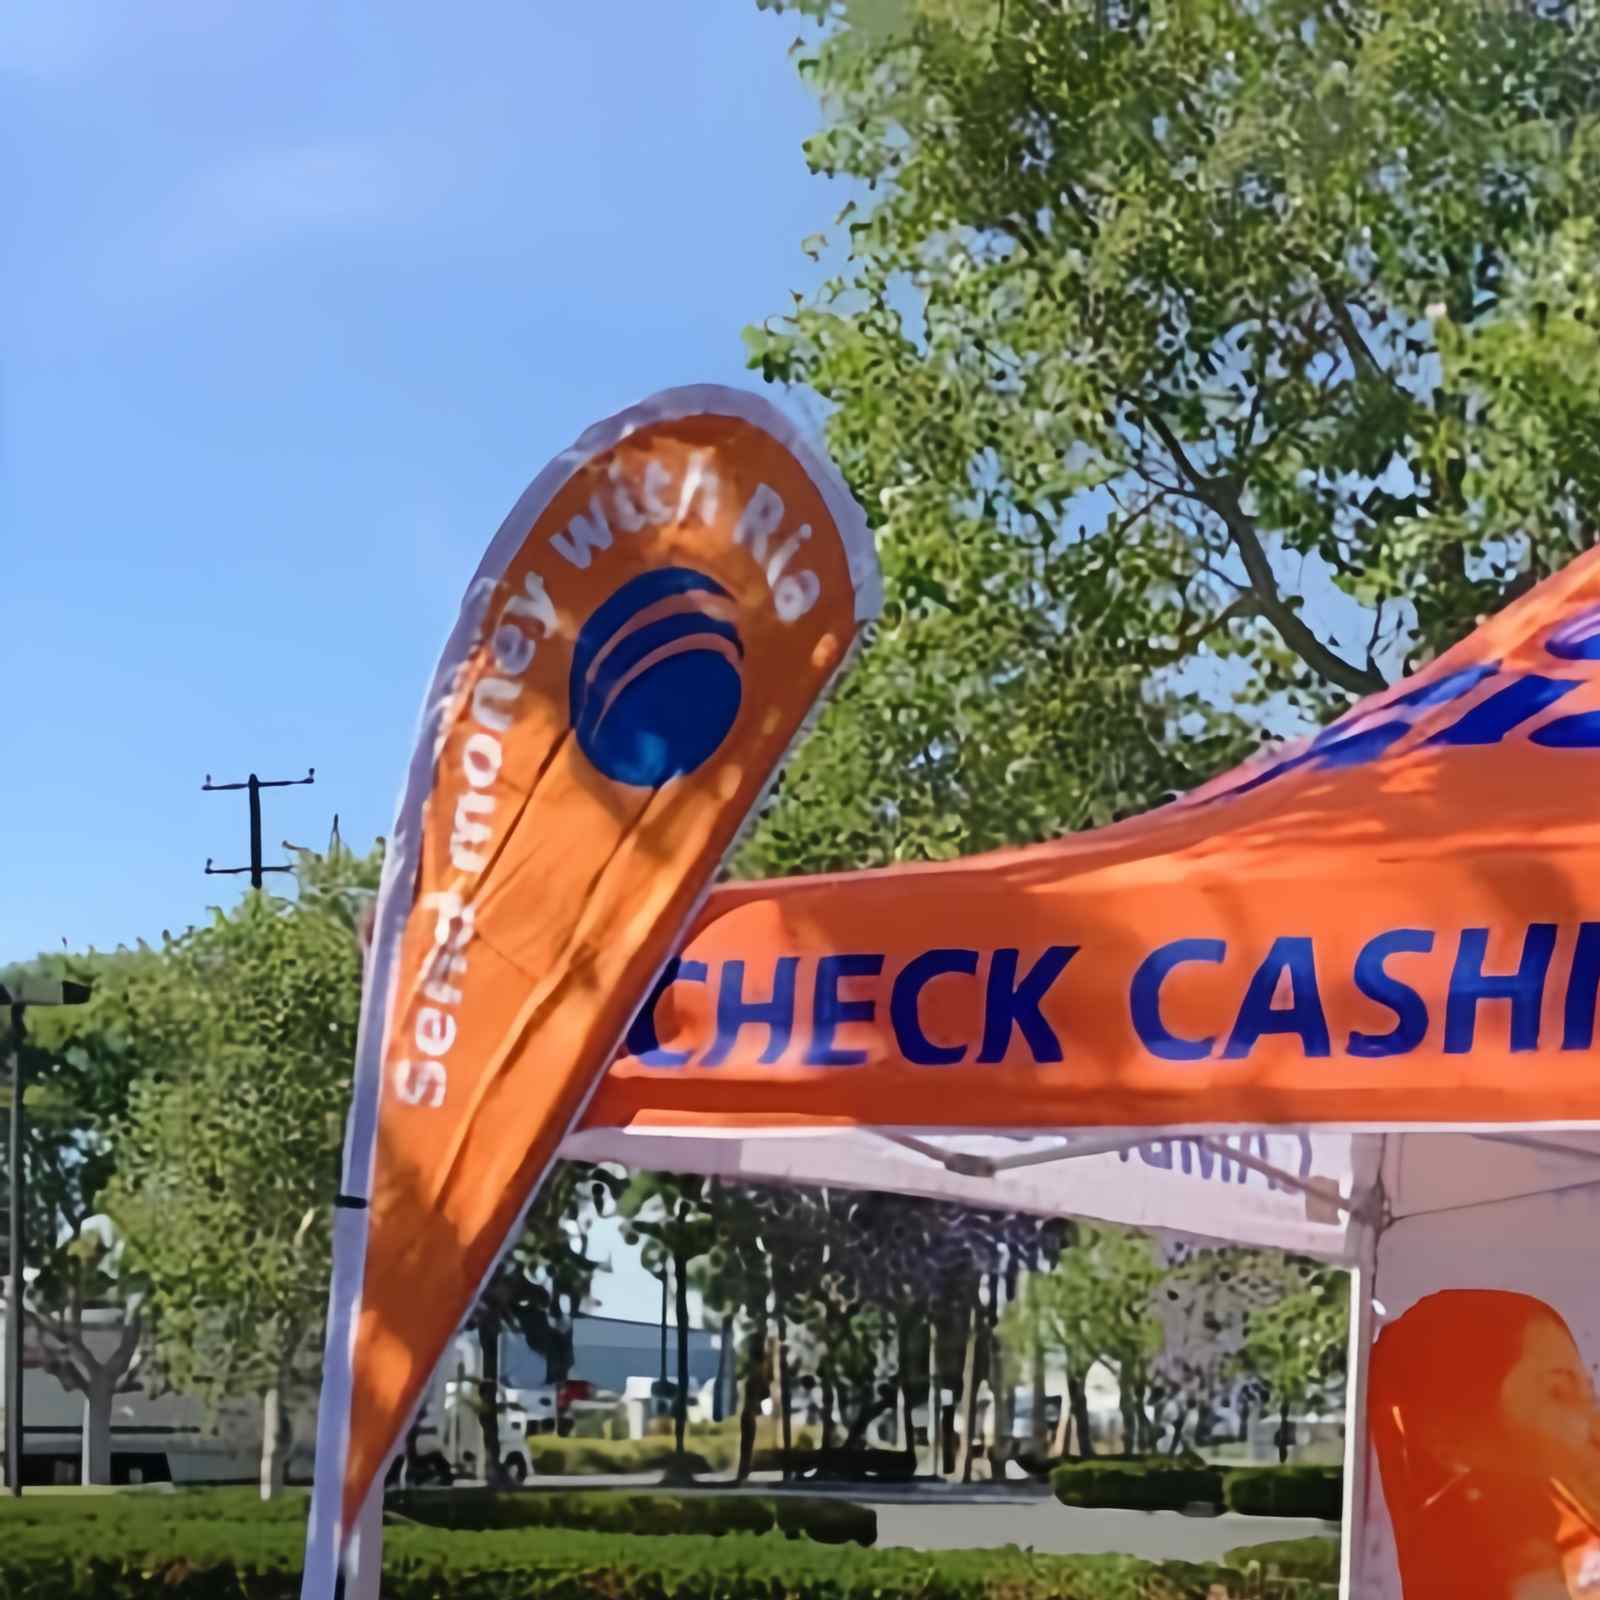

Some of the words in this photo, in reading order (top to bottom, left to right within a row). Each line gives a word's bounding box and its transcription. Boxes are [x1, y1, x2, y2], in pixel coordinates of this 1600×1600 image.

[394, 890, 475, 1109] Send
[449, 571, 559, 874] money
[549, 451, 722, 570] with
[734, 483, 821, 623] Ria
[624, 945, 1080, 1068] CHECK
